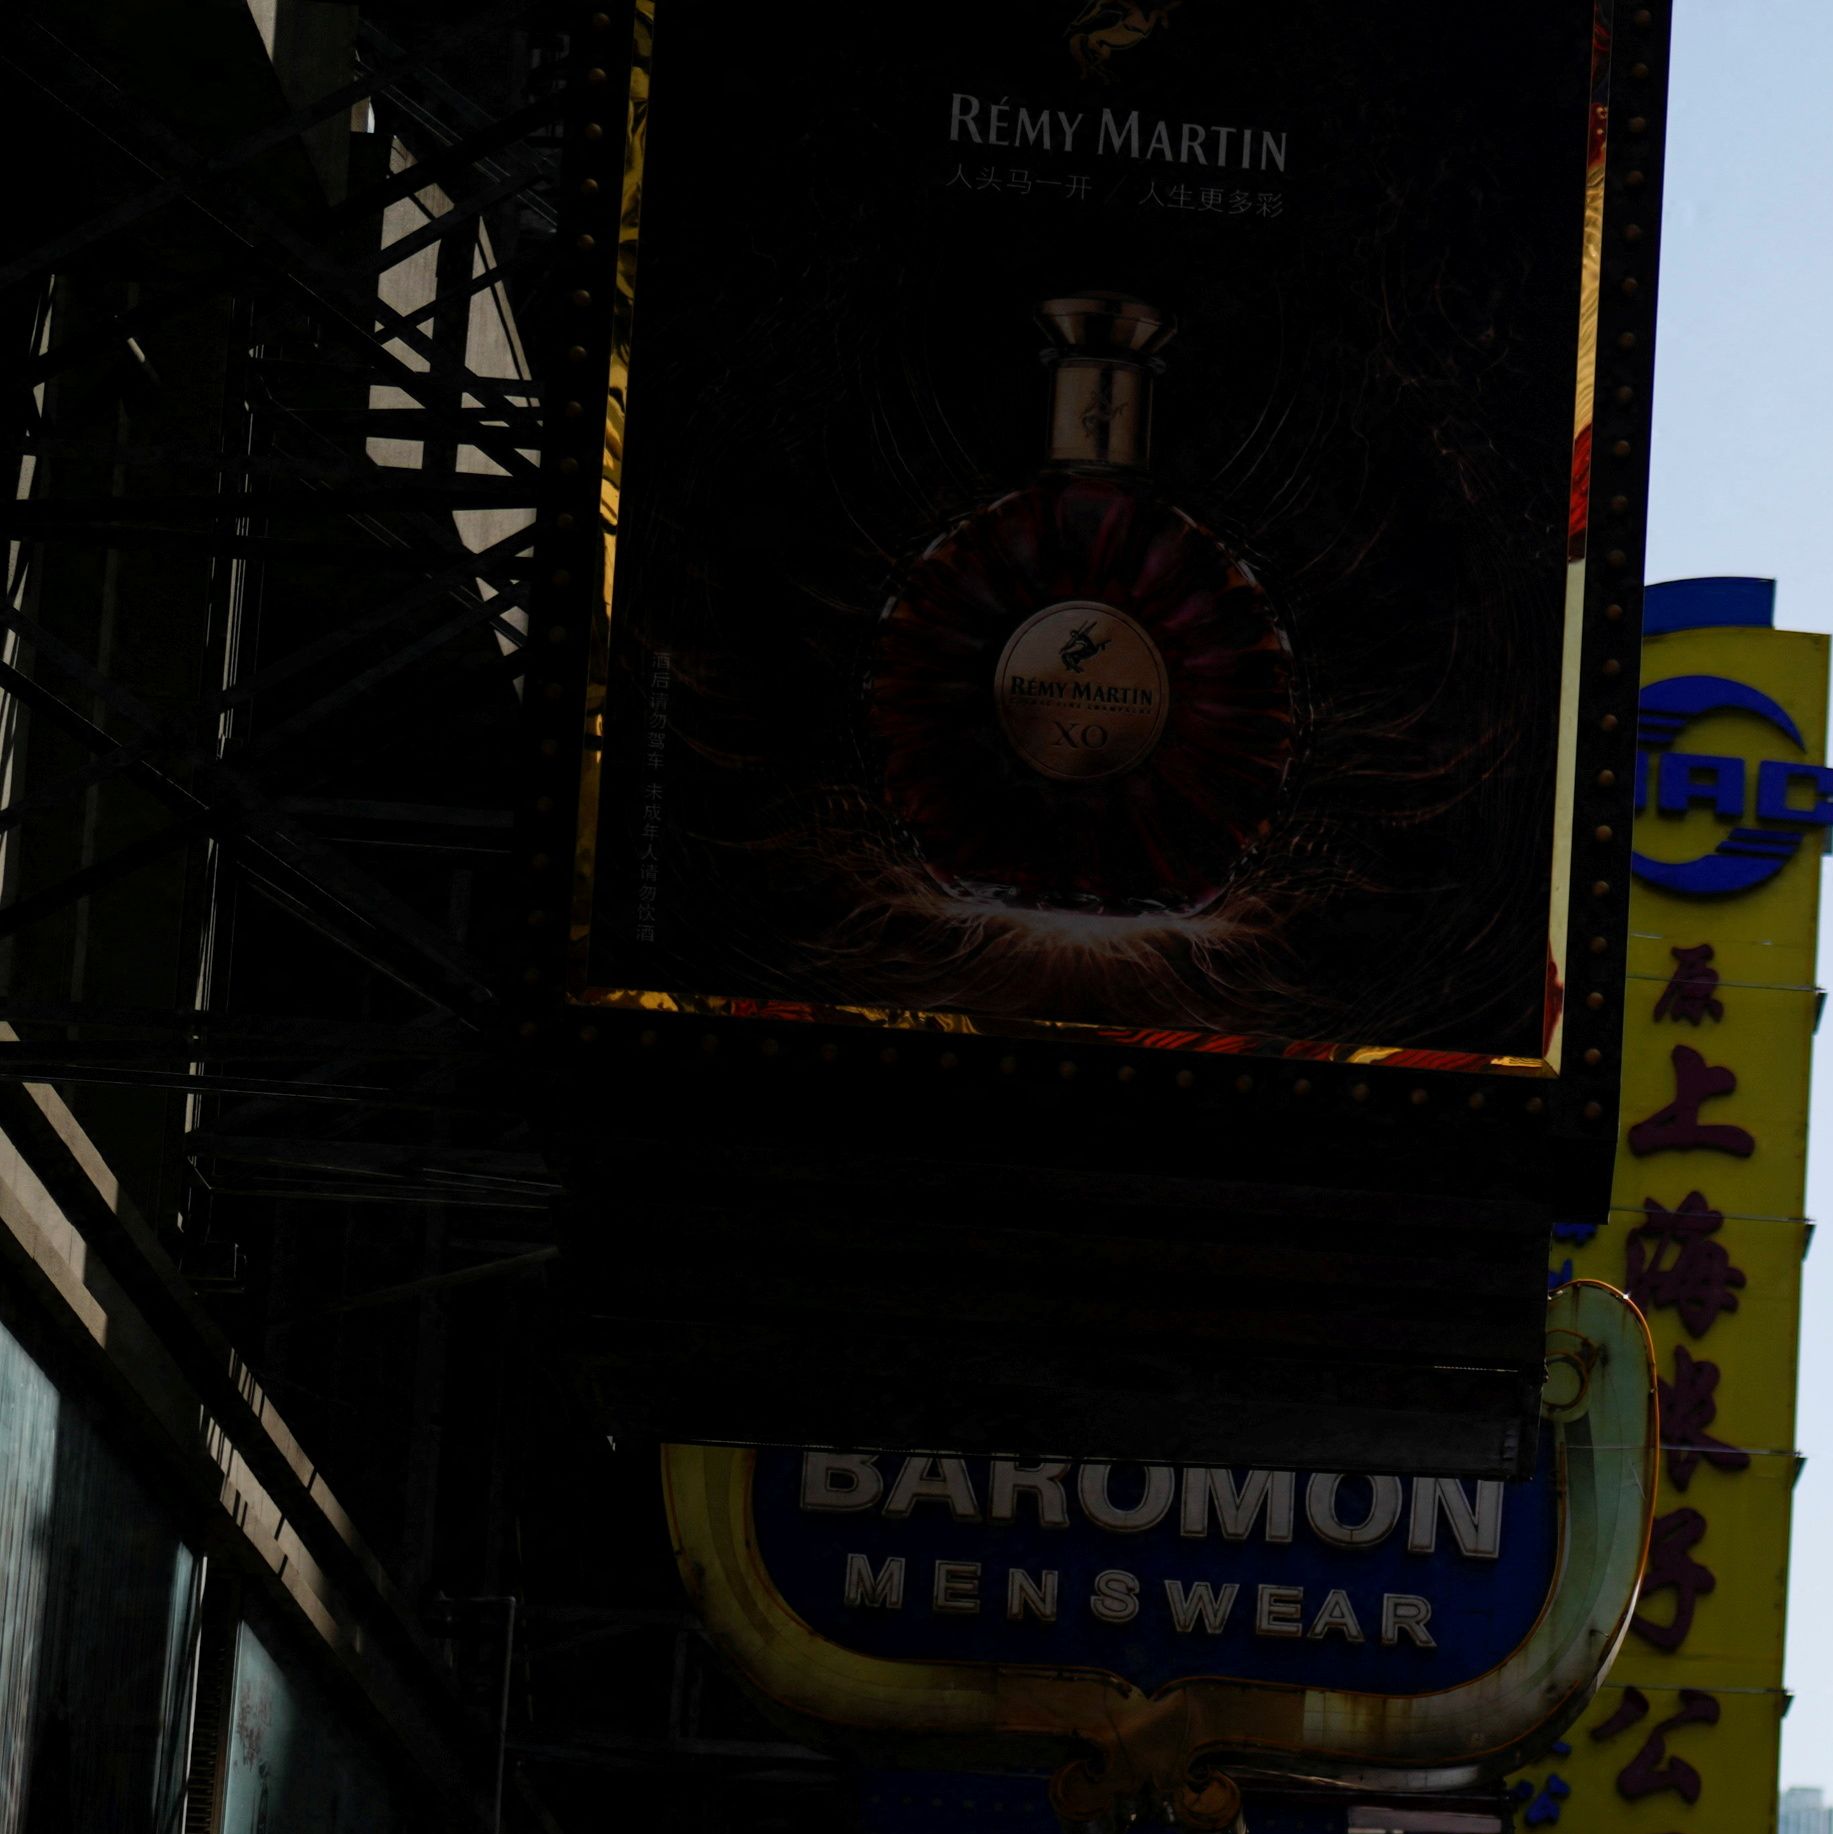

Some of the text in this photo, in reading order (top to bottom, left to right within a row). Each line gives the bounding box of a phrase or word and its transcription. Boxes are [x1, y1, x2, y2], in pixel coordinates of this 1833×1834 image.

[948, 92, 1288, 173] RÉMY MARTIN
[944, 162, 1287, 219] 人头马一开 人生更多彩
[1010, 674, 1066, 699] RÉMY
[1072, 681, 1153, 706] MARTIN
[1049, 720, 1109, 751] XO
[800, 1449, 1504, 1561] BAROMON
